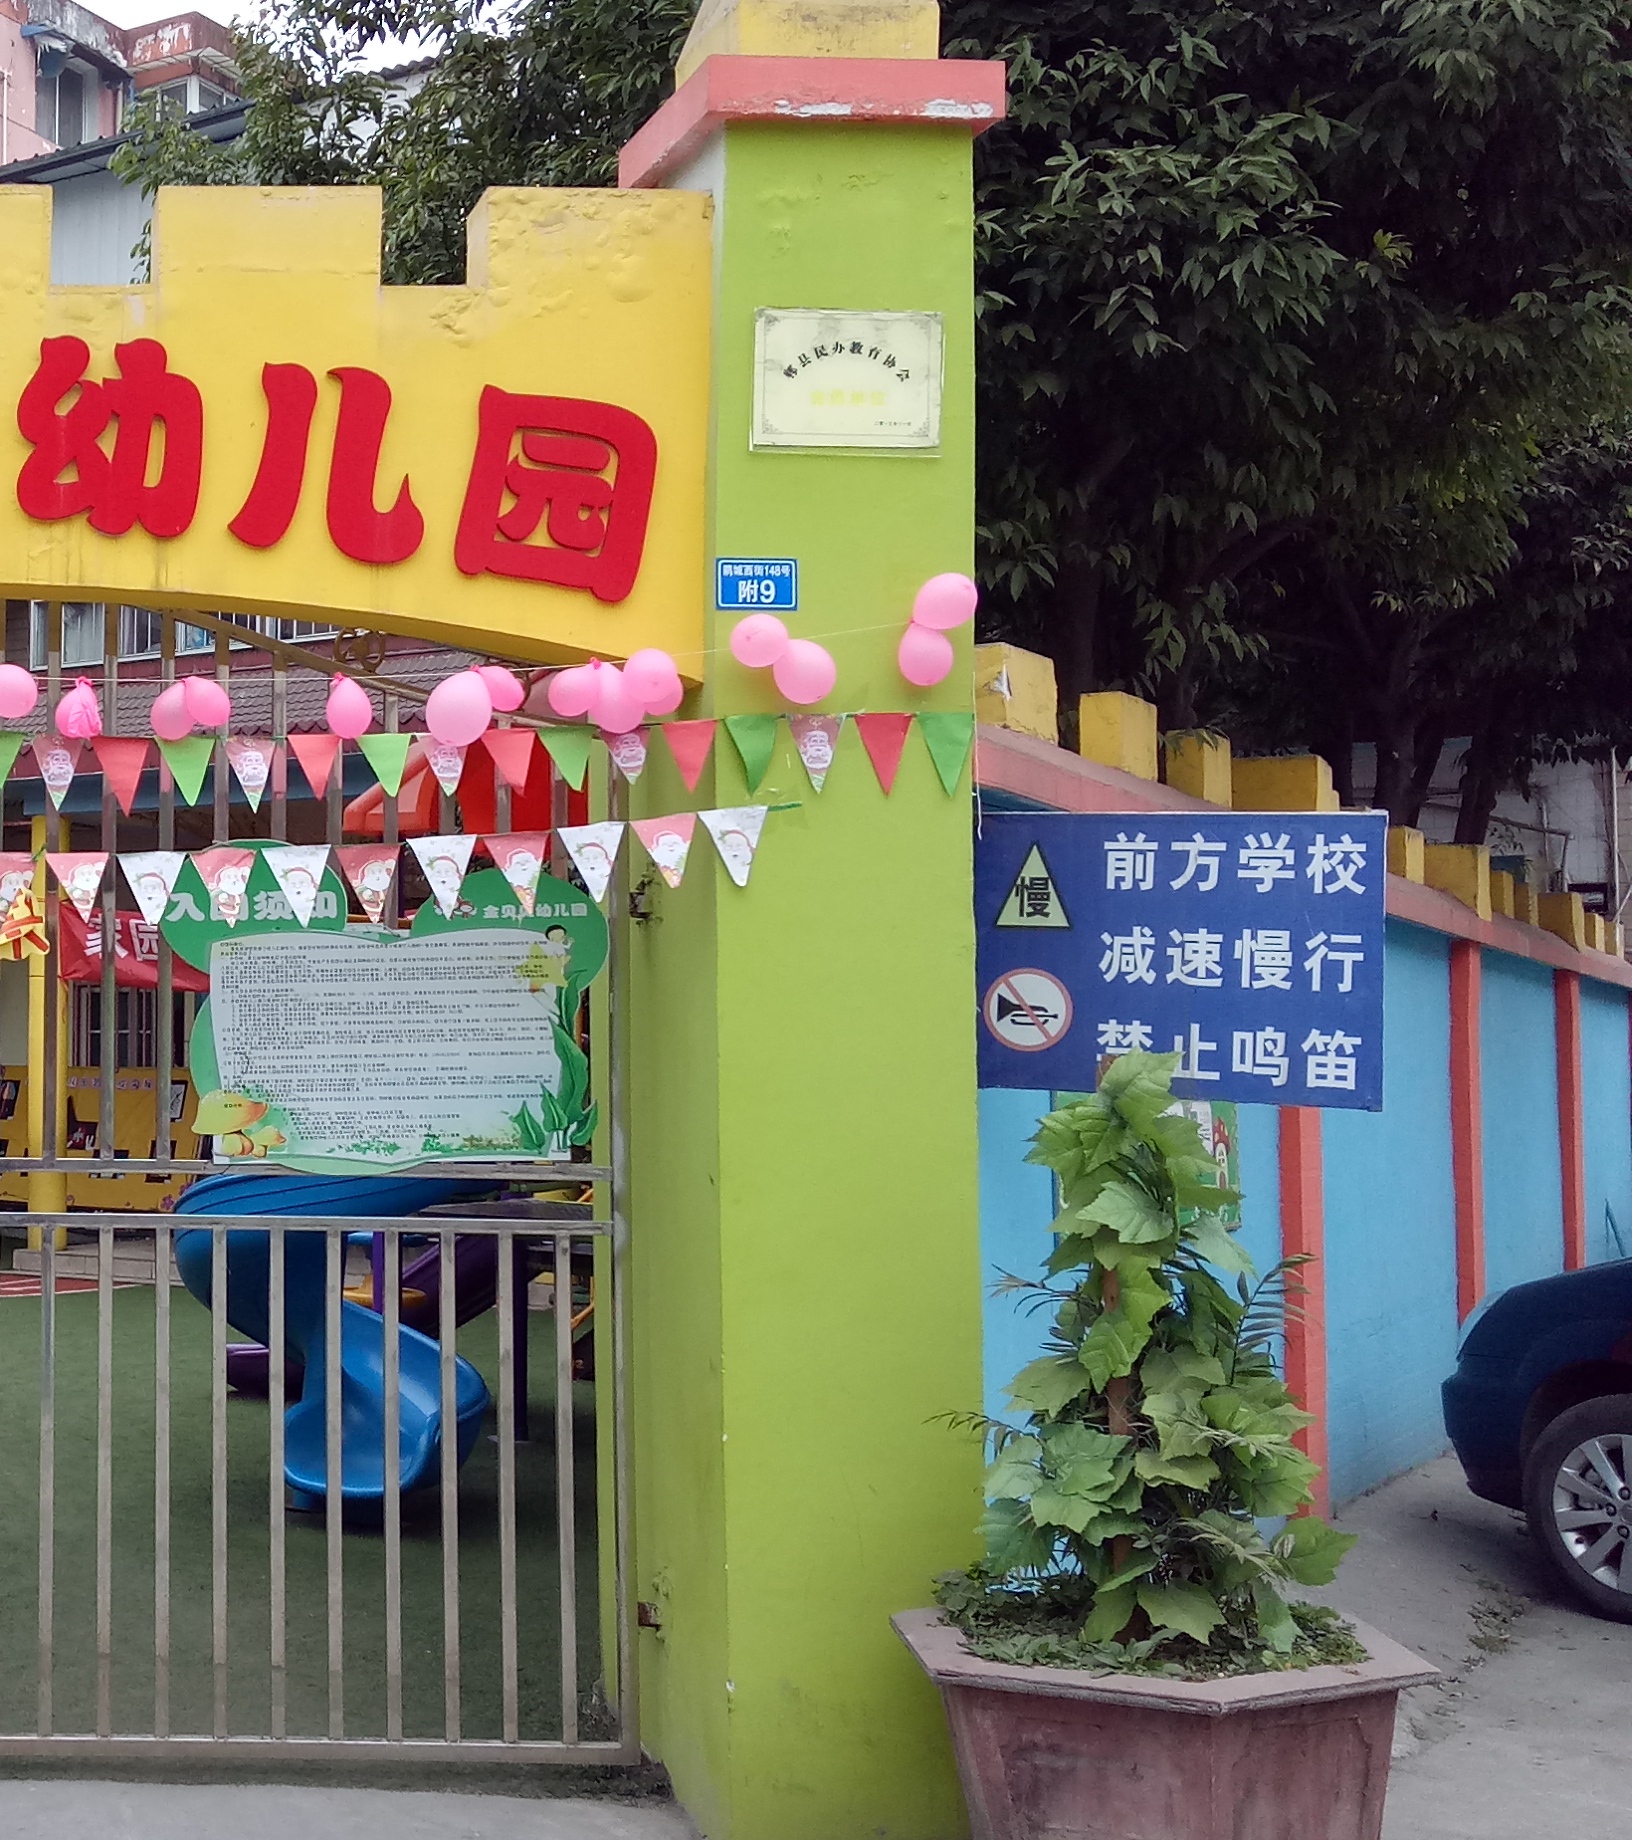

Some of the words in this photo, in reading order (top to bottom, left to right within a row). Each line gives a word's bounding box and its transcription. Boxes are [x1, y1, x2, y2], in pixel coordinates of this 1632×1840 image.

[738, 579, 776, 604] 附9
[1103, 832, 1369, 895] 前方学校
[1014, 875, 1051, 920] 慢
[1098, 926, 1365, 993] 减速慢行
